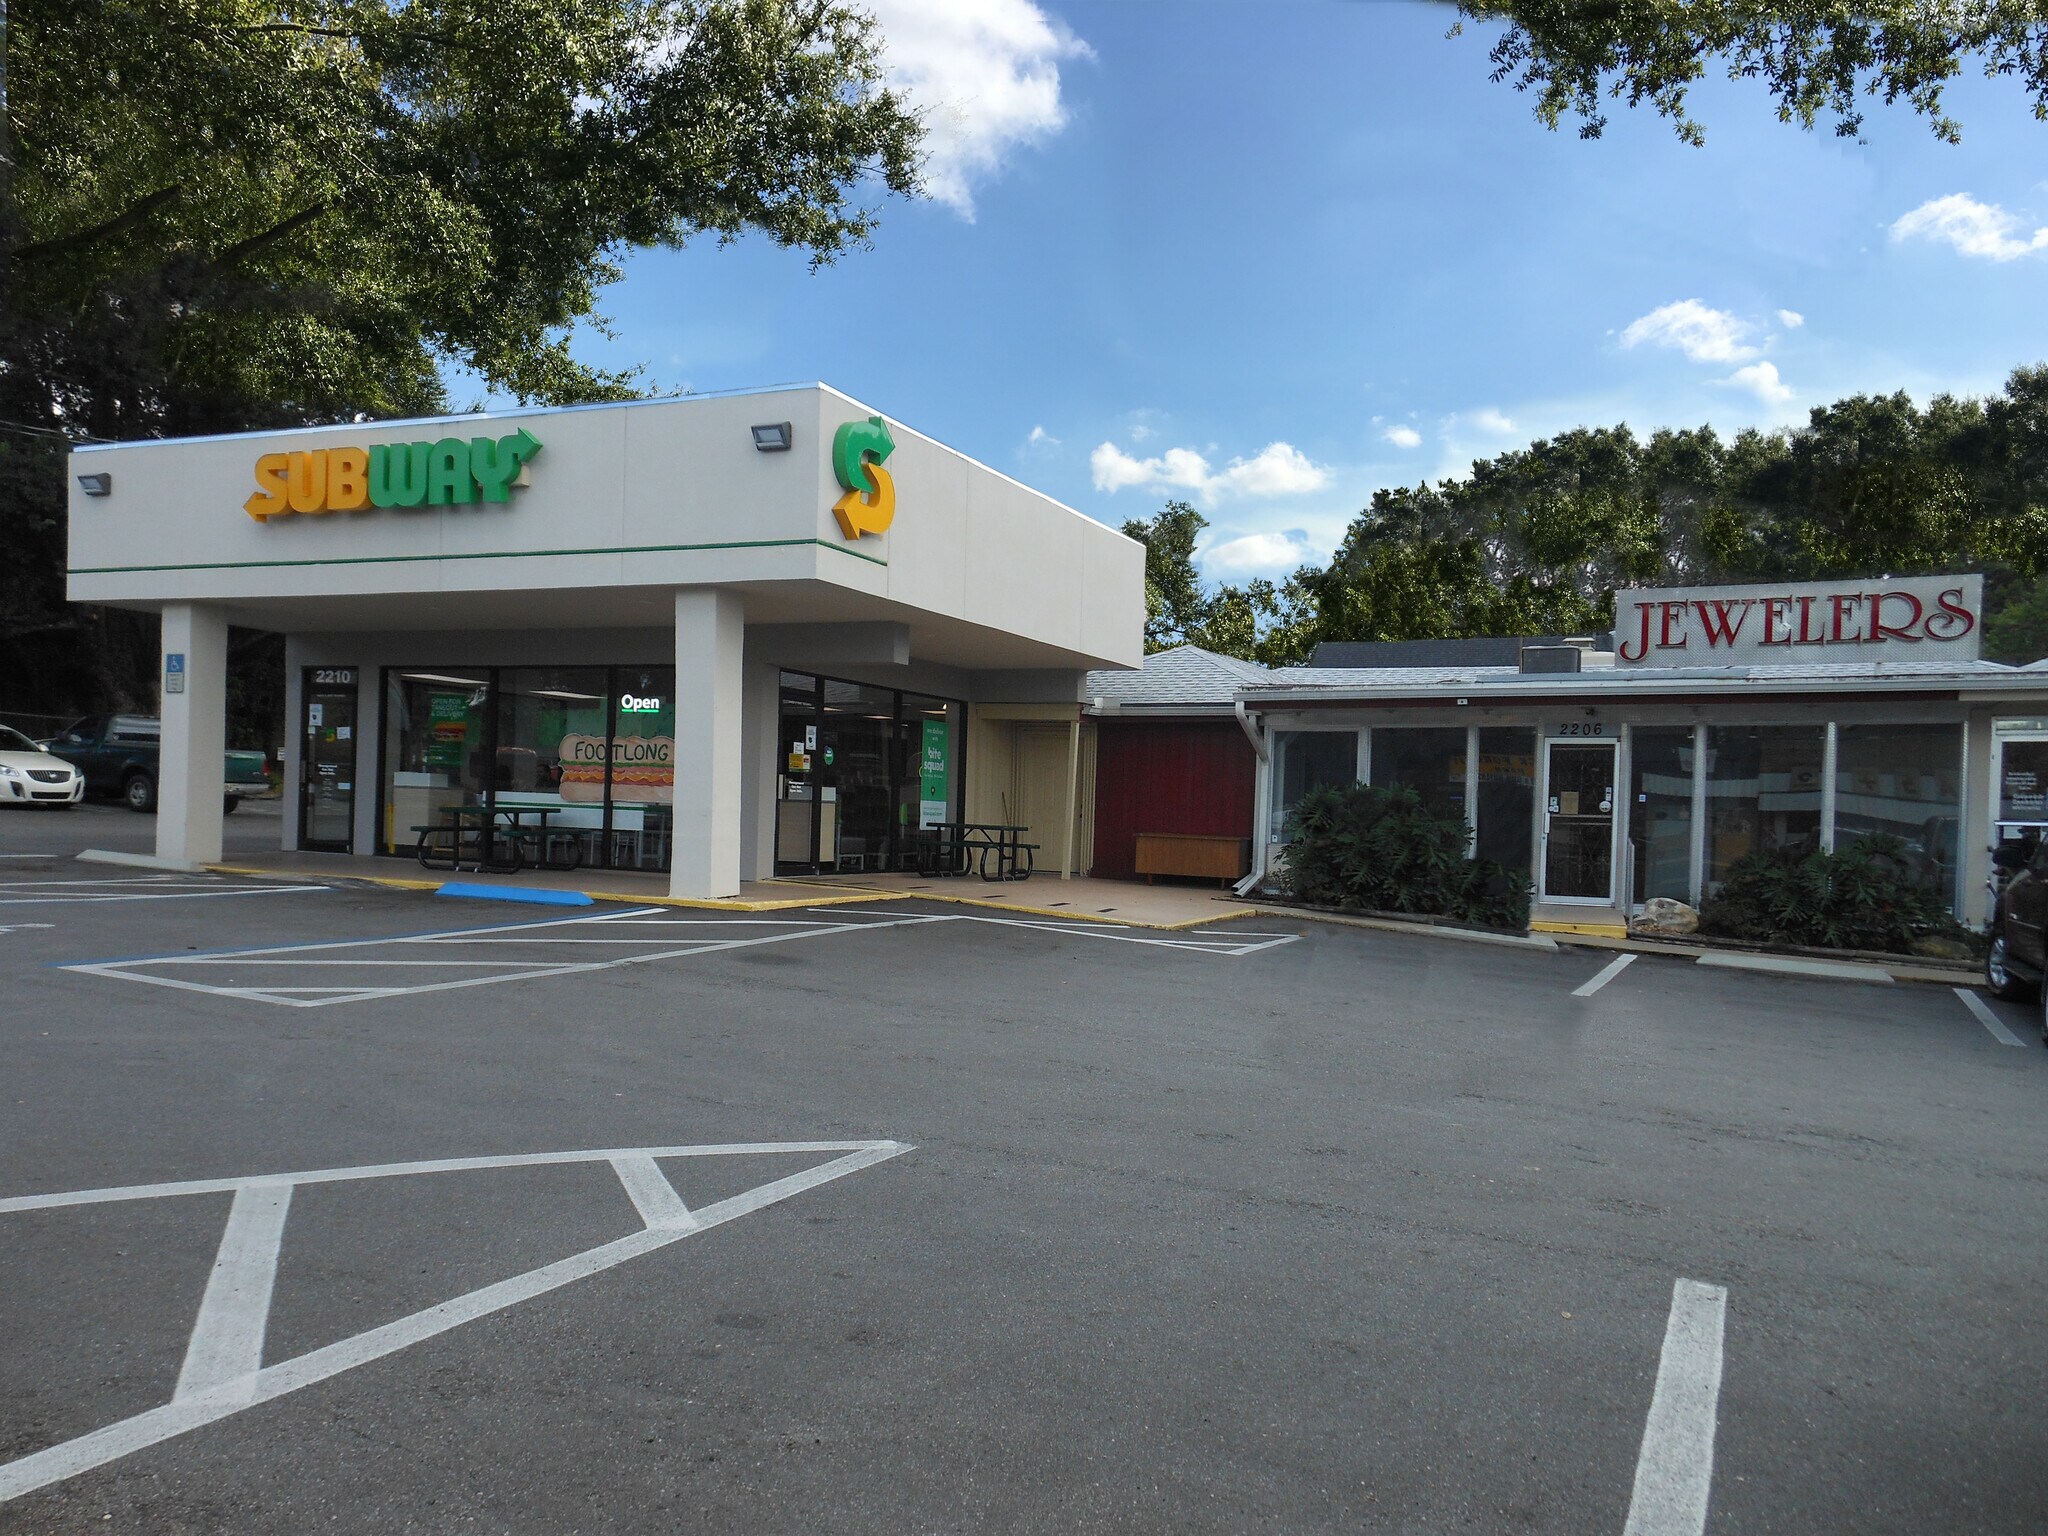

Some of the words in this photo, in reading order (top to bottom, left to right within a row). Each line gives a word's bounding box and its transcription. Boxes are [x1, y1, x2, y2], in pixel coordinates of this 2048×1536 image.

[243, 427, 543, 523] SUBWAY
[1619, 587, 1975, 662] JEWELERS
[316, 670, 350, 683] 2210
[621, 694, 660, 713] Open
[1560, 723, 1602, 736] 2206
[575, 741, 669, 761] FOOTLONG
